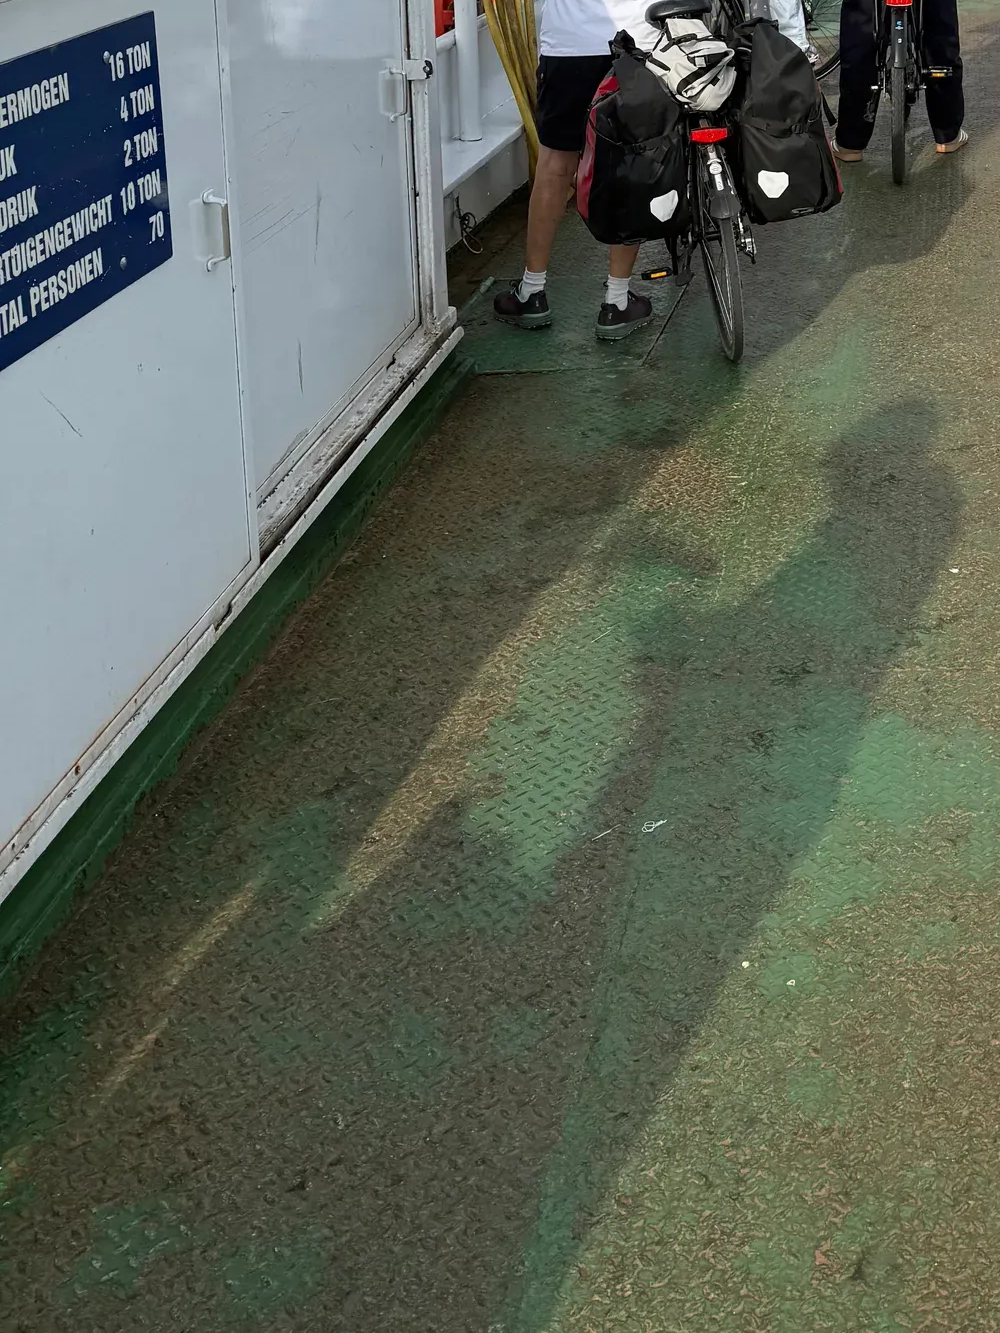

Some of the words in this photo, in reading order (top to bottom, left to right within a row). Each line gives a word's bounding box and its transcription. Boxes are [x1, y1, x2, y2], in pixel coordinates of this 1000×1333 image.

[108, 51, 125, 81] 16
[126, 41, 151, 74] TON
[120, 96, 129, 122] 4
[130, 84, 155, 119] TON
[123, 139, 133, 167] 2
[133, 126, 158, 161] TON
[120, 181, 136, 215] 10
[137, 168, 161, 204] TON
[0, 295, 28, 339] TAL
[29, 247, 103, 317] PERSONEN
[149, 210, 164, 243] 70
